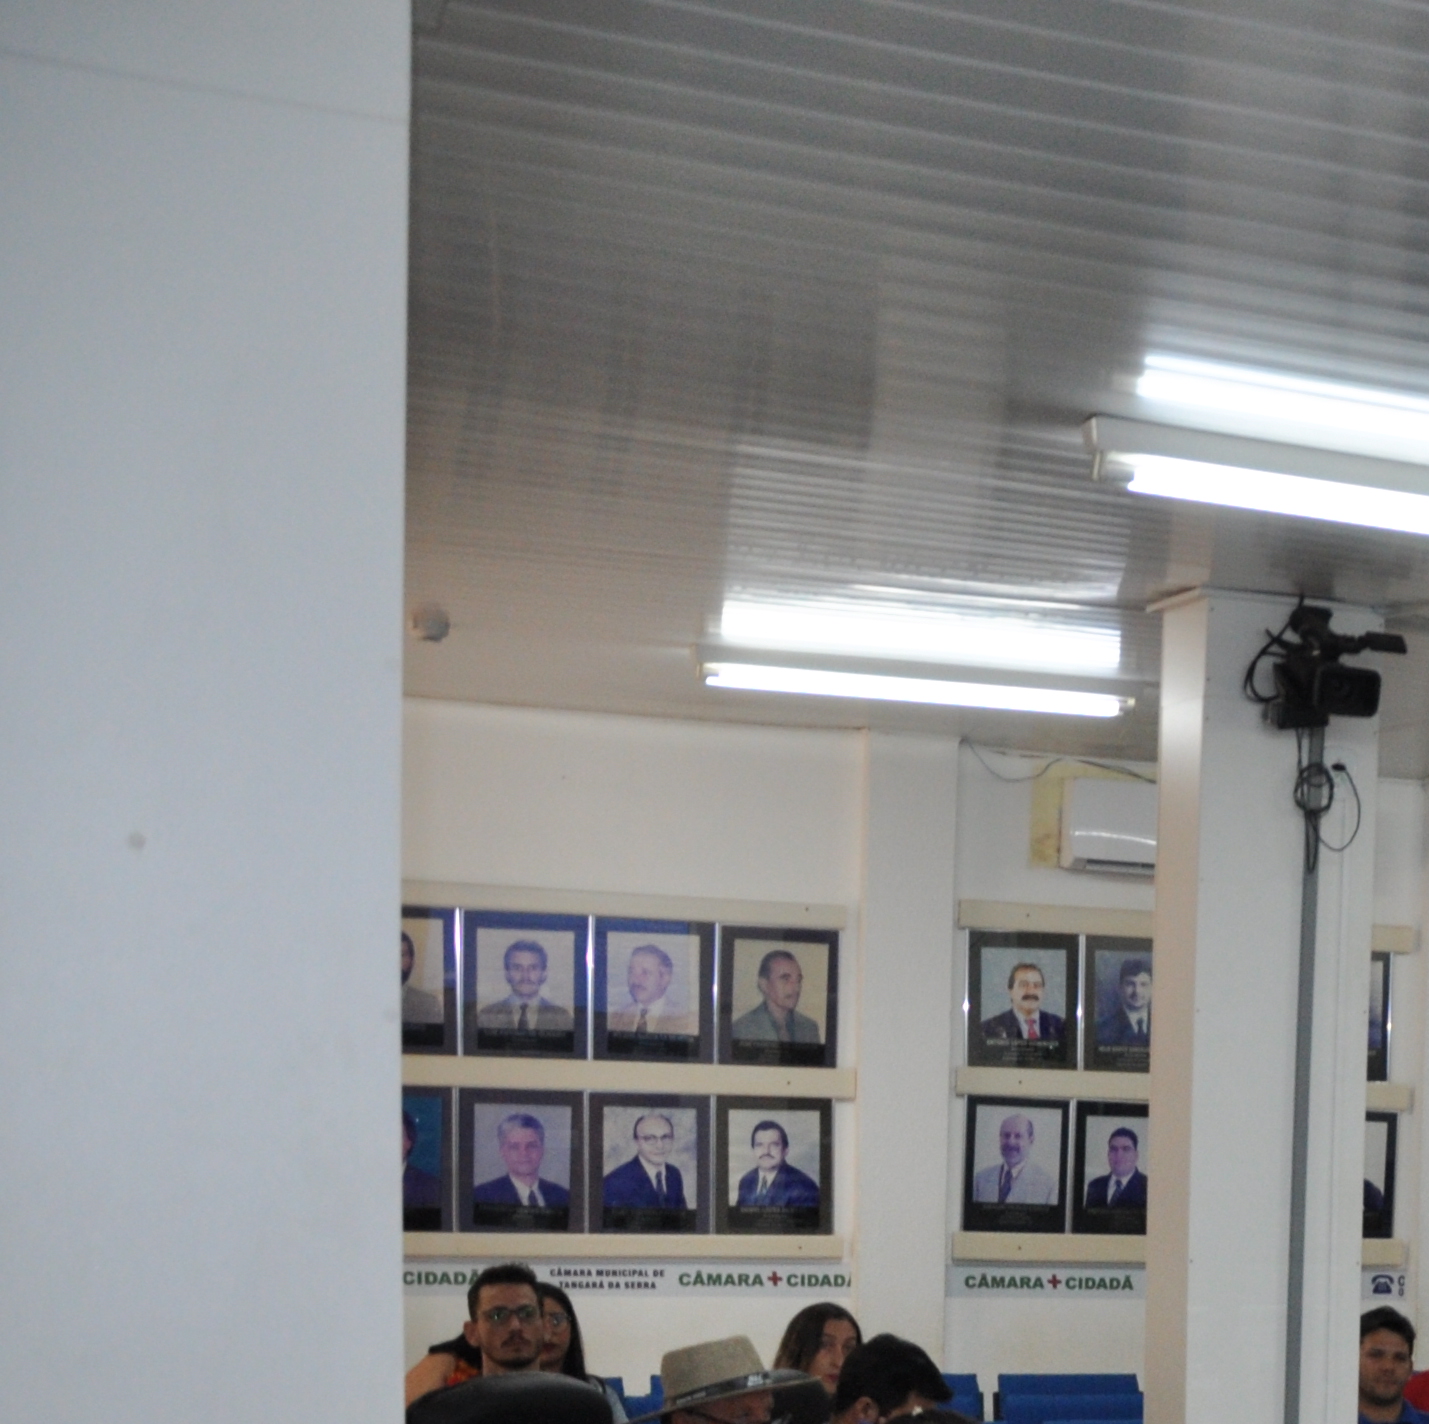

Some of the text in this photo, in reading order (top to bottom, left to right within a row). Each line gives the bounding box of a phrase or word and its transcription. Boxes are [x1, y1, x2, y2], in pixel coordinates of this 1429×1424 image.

[550, 1267, 665, 1278] CÂMARA MUNICIPAL DE
[678, 1270, 764, 1288] CÂMARA
[786, 1272, 852, 1288] CIDAD
[608, 1281, 621, 1290] DA
[624, 1281, 657, 1290] SERRA
[964, 1273, 1044, 1290] CÂMARA
[1065, 1275, 1134, 1291] CIDADÃ
